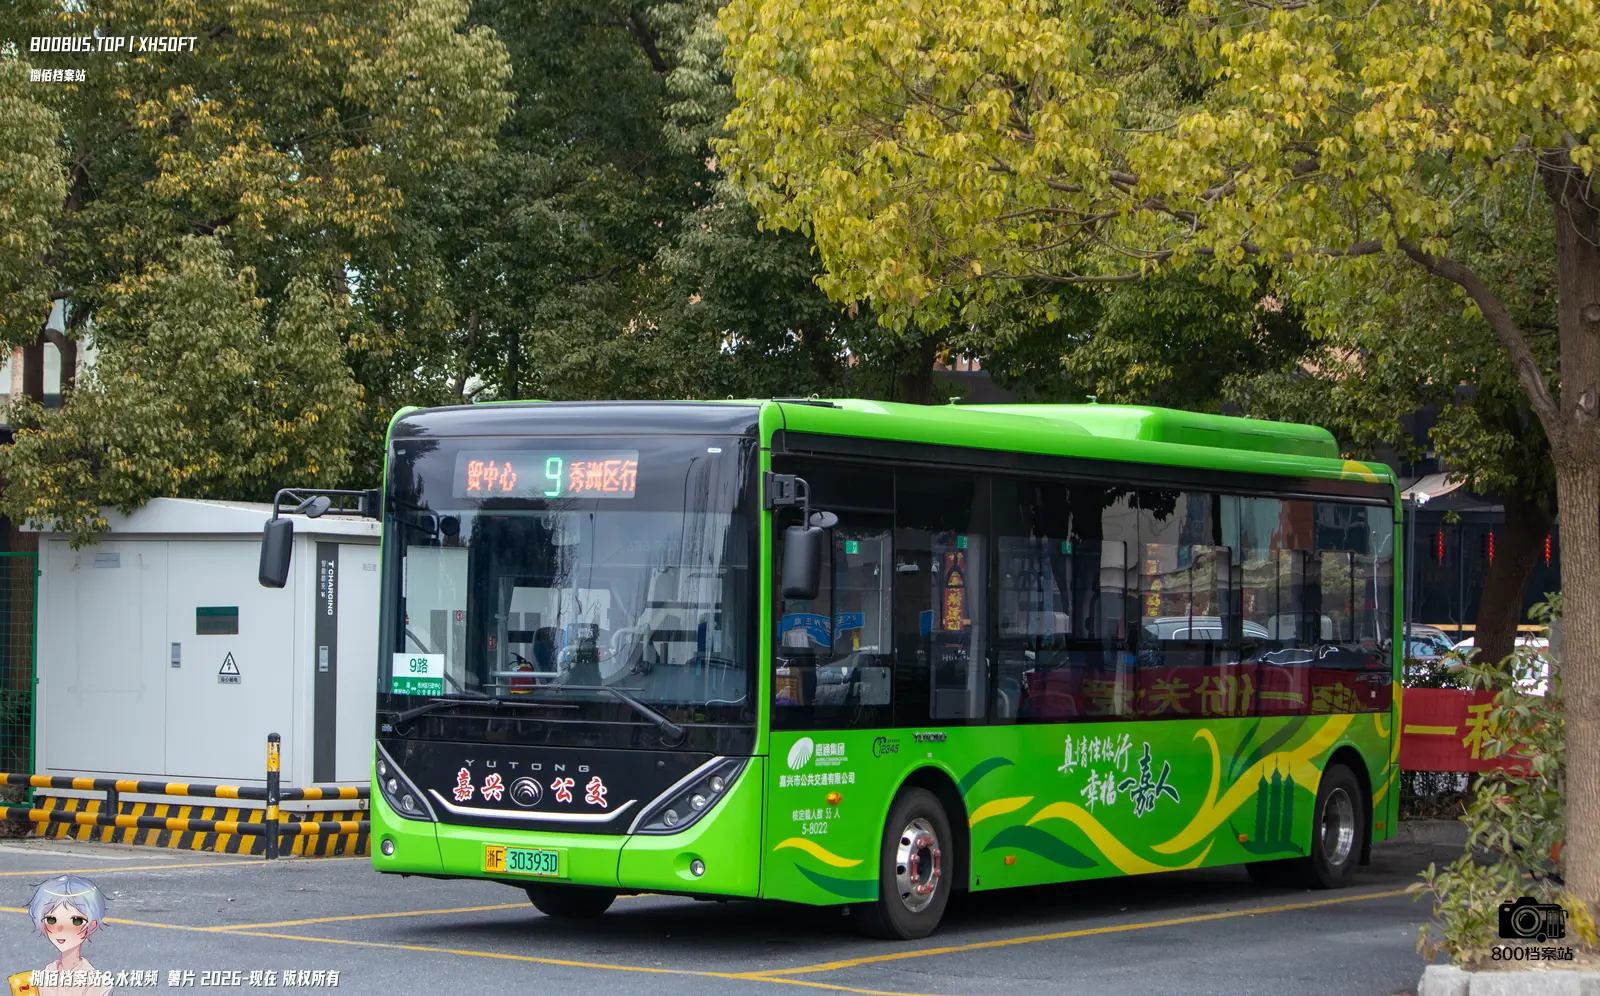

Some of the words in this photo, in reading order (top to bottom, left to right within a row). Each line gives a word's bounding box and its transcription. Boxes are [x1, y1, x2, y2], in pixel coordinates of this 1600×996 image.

[545, 456, 563, 497] 9
[409, 658, 428, 674] 9路
[465, 759, 590, 773] YUTONG
[453, 767, 505, 802] 嘉兴
[550, 776, 608, 808] 公交
[779, 771, 855, 788] 嘉兴市公共交通有限公司
[801, 821, 828, 835] 5-8022
[509, 851, 558, 872] 30393D
